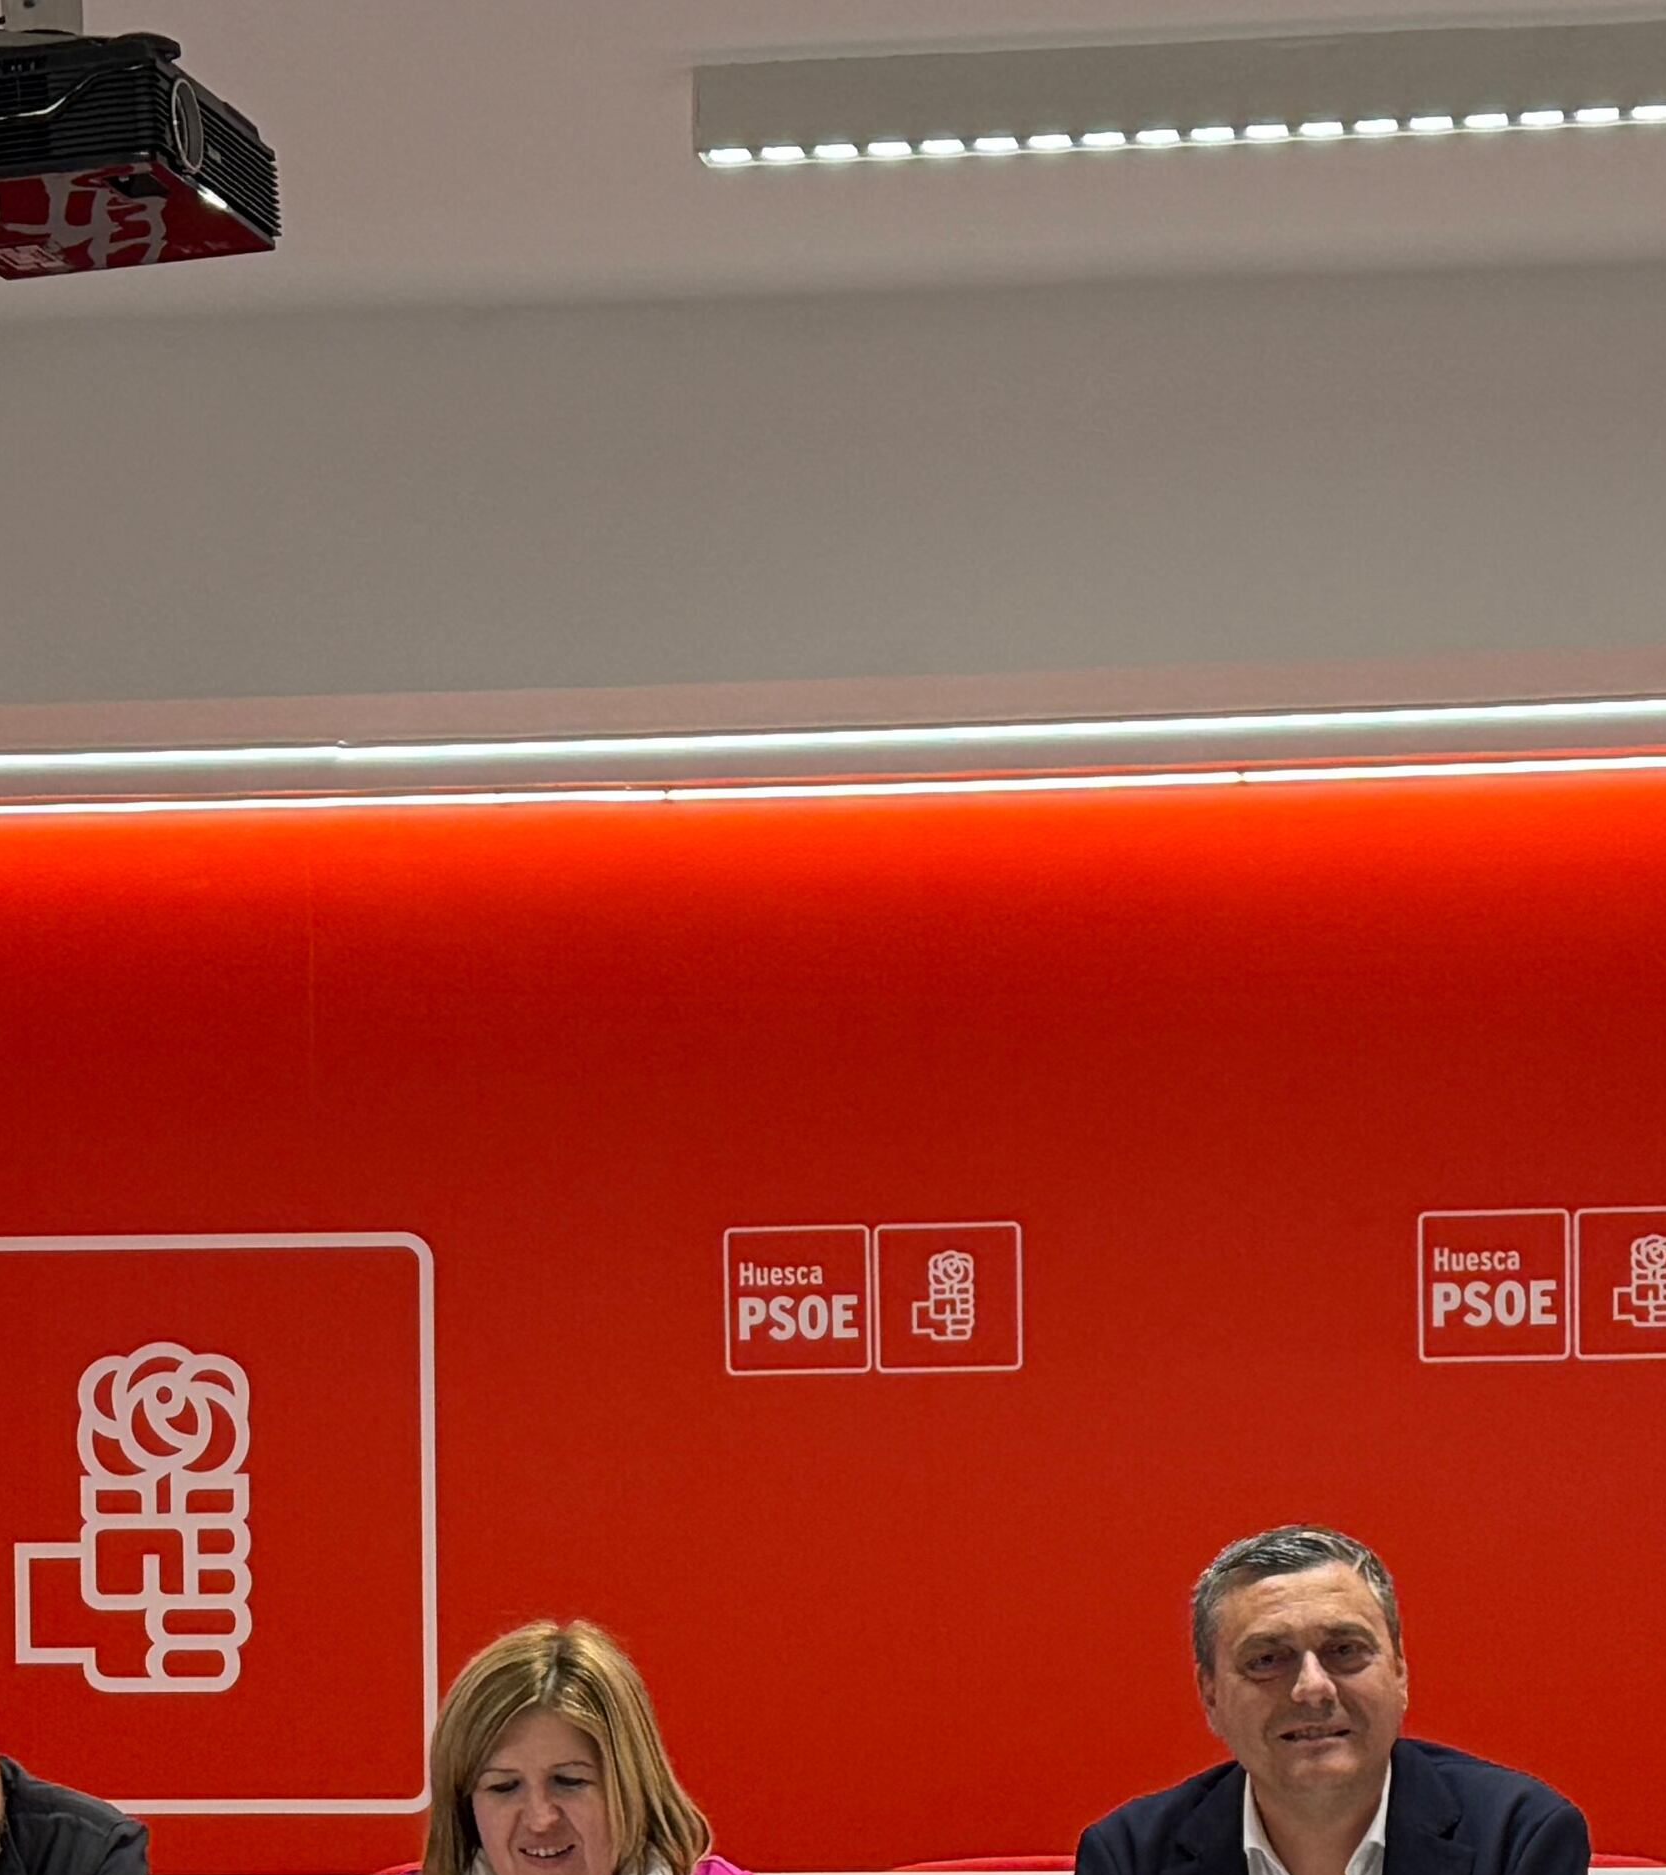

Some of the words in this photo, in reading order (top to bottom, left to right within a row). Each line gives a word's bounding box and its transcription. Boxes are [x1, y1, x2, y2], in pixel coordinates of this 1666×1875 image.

[739, 1262, 823, 1287] Huesca
[1434, 1247, 1520, 1272] Huesca
[738, 1294, 859, 1341] PSOE
[1432, 1279, 1557, 1327] PSOE
